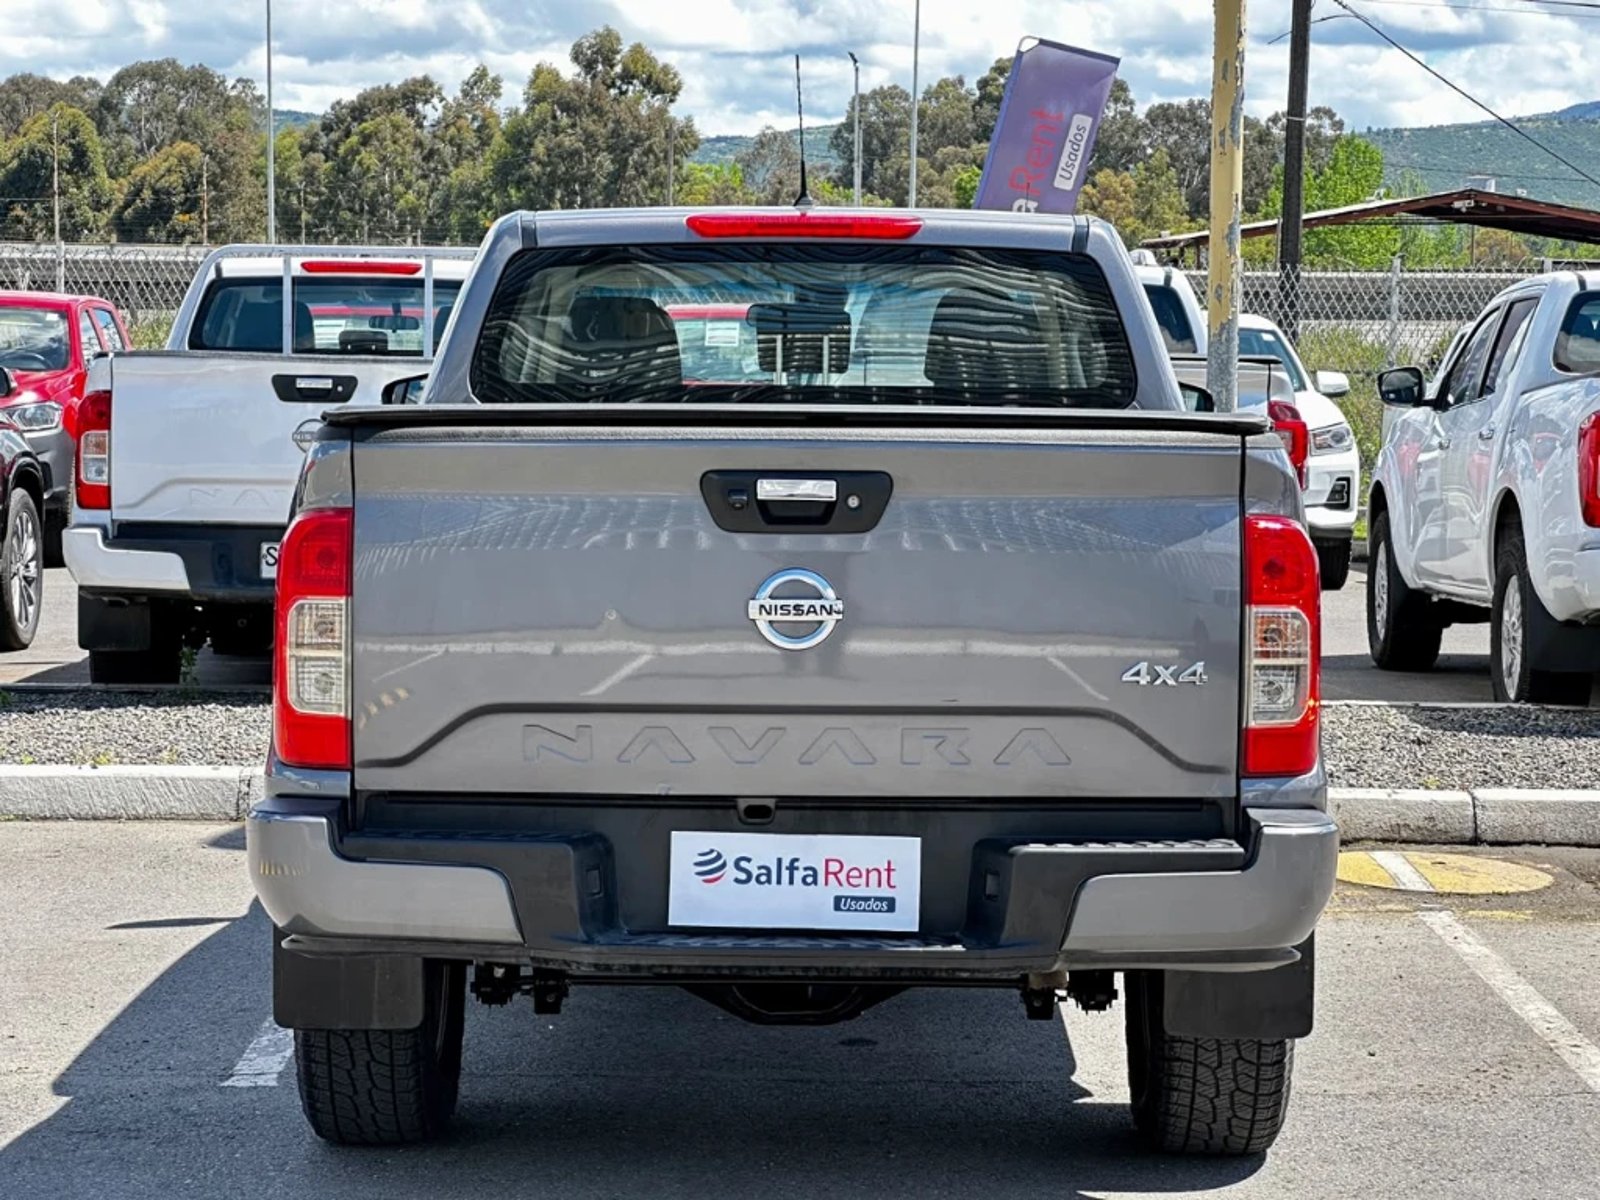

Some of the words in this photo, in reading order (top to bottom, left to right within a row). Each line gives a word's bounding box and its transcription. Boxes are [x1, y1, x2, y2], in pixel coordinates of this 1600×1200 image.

[1059, 124, 1086, 181] Usados
[758, 604, 834, 616] NISSAN
[1121, 661, 1208, 686] 4x4
[522, 724, 1072, 765] NAVARA
[733, 855, 897, 889] SalfaRent
[840, 897, 889, 912] Usados
